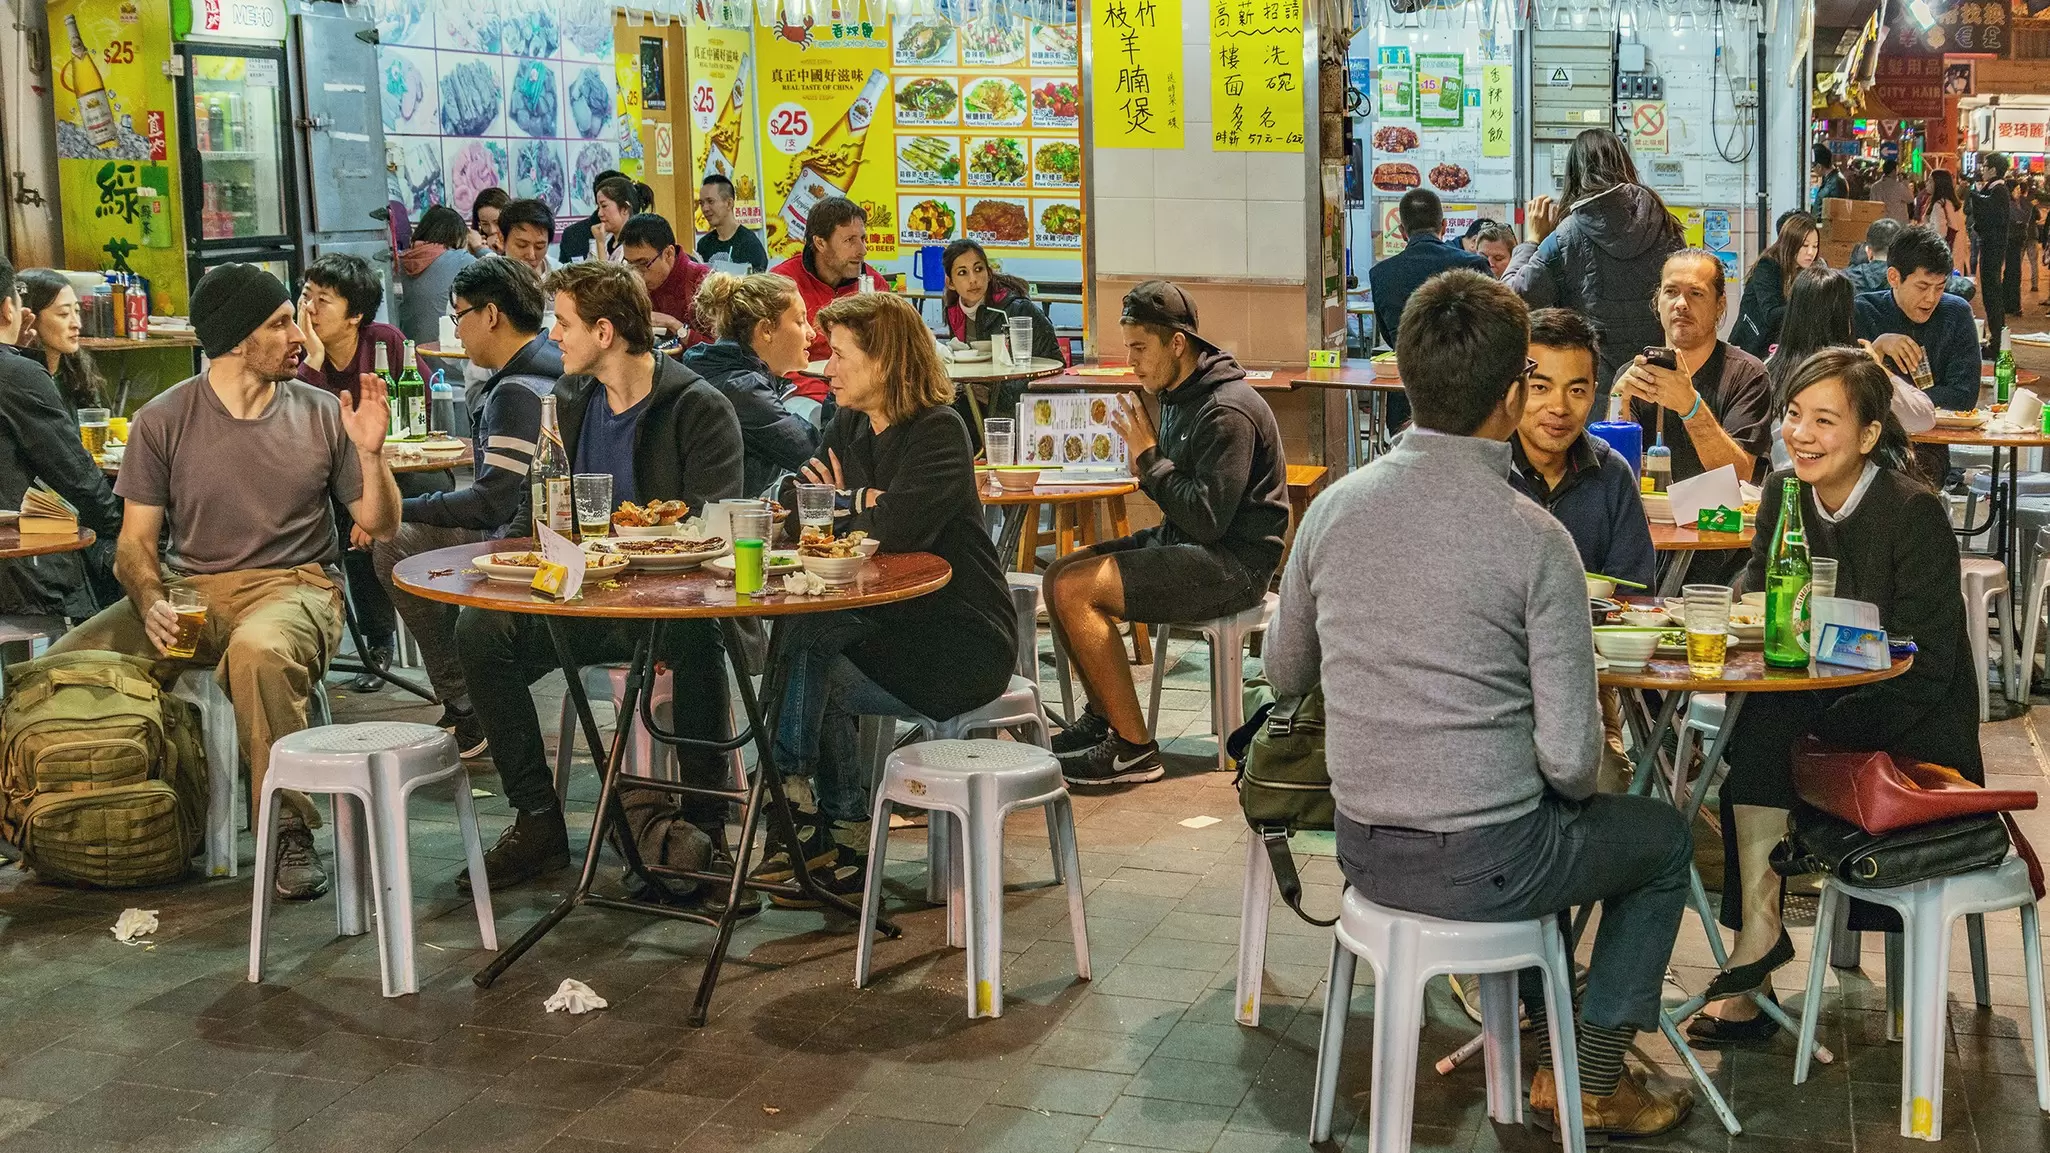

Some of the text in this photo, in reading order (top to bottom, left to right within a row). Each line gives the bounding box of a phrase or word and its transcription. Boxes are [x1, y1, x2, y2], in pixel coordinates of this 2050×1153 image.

[103, 41, 134, 64] $25
[771, 68, 865, 83] 真正中國好滋味
[1912, 86, 1941, 100] HAIR
[770, 110, 808, 136] $25
[1999, 122, 2045, 138] 愛琦麗
